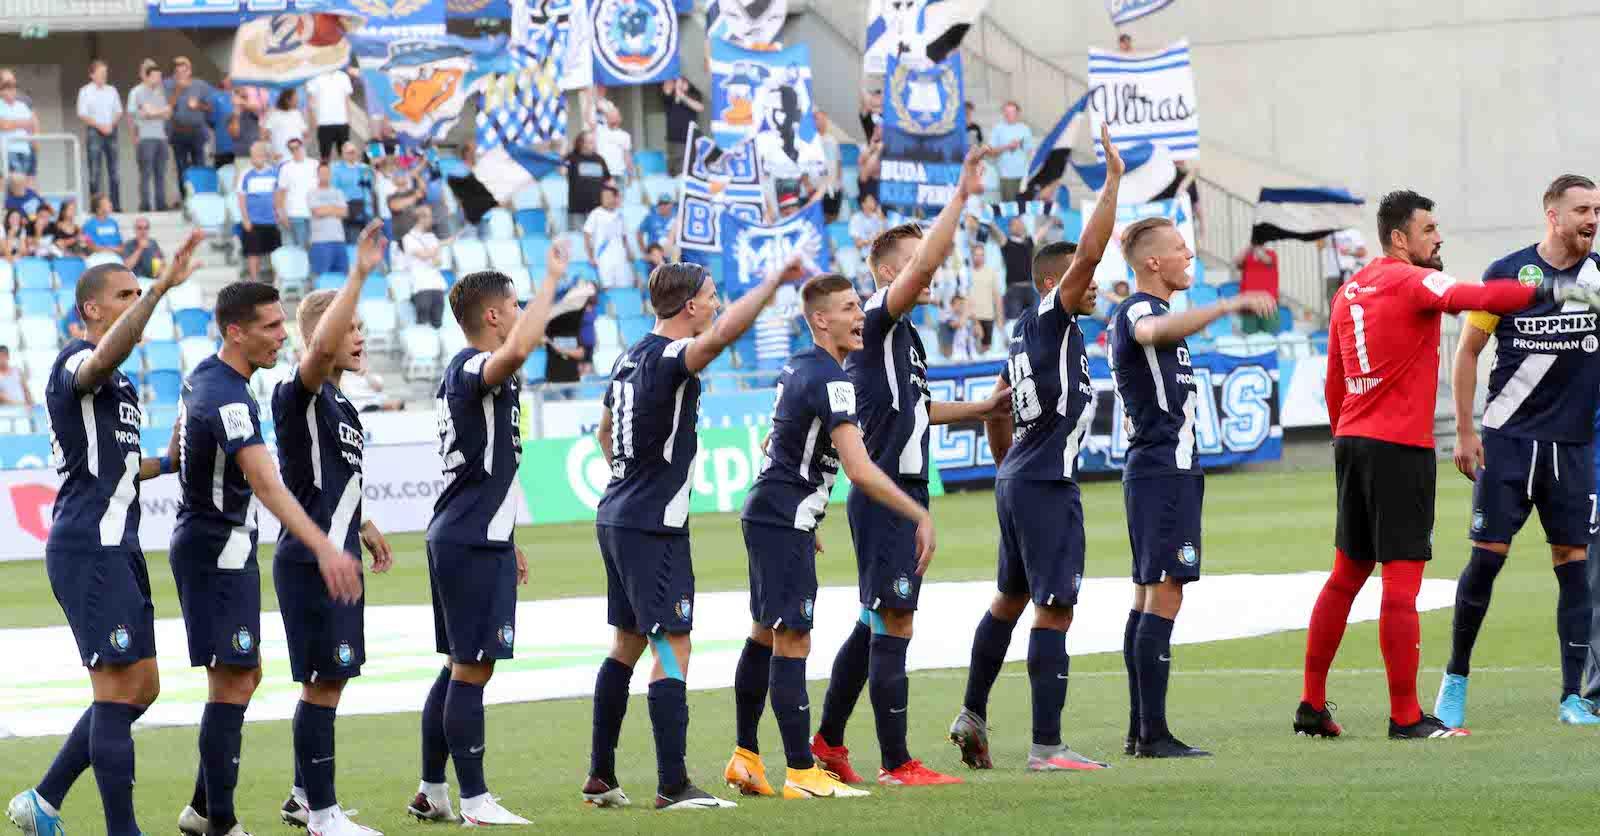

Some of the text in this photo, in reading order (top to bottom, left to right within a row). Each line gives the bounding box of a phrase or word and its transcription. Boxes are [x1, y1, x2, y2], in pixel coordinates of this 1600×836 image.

[1092, 84, 1192, 126] Ultras
[1349, 304, 1371, 374] 1
[1513, 338, 1579, 350] PROHUMAN
[611, 380, 634, 458] 11
